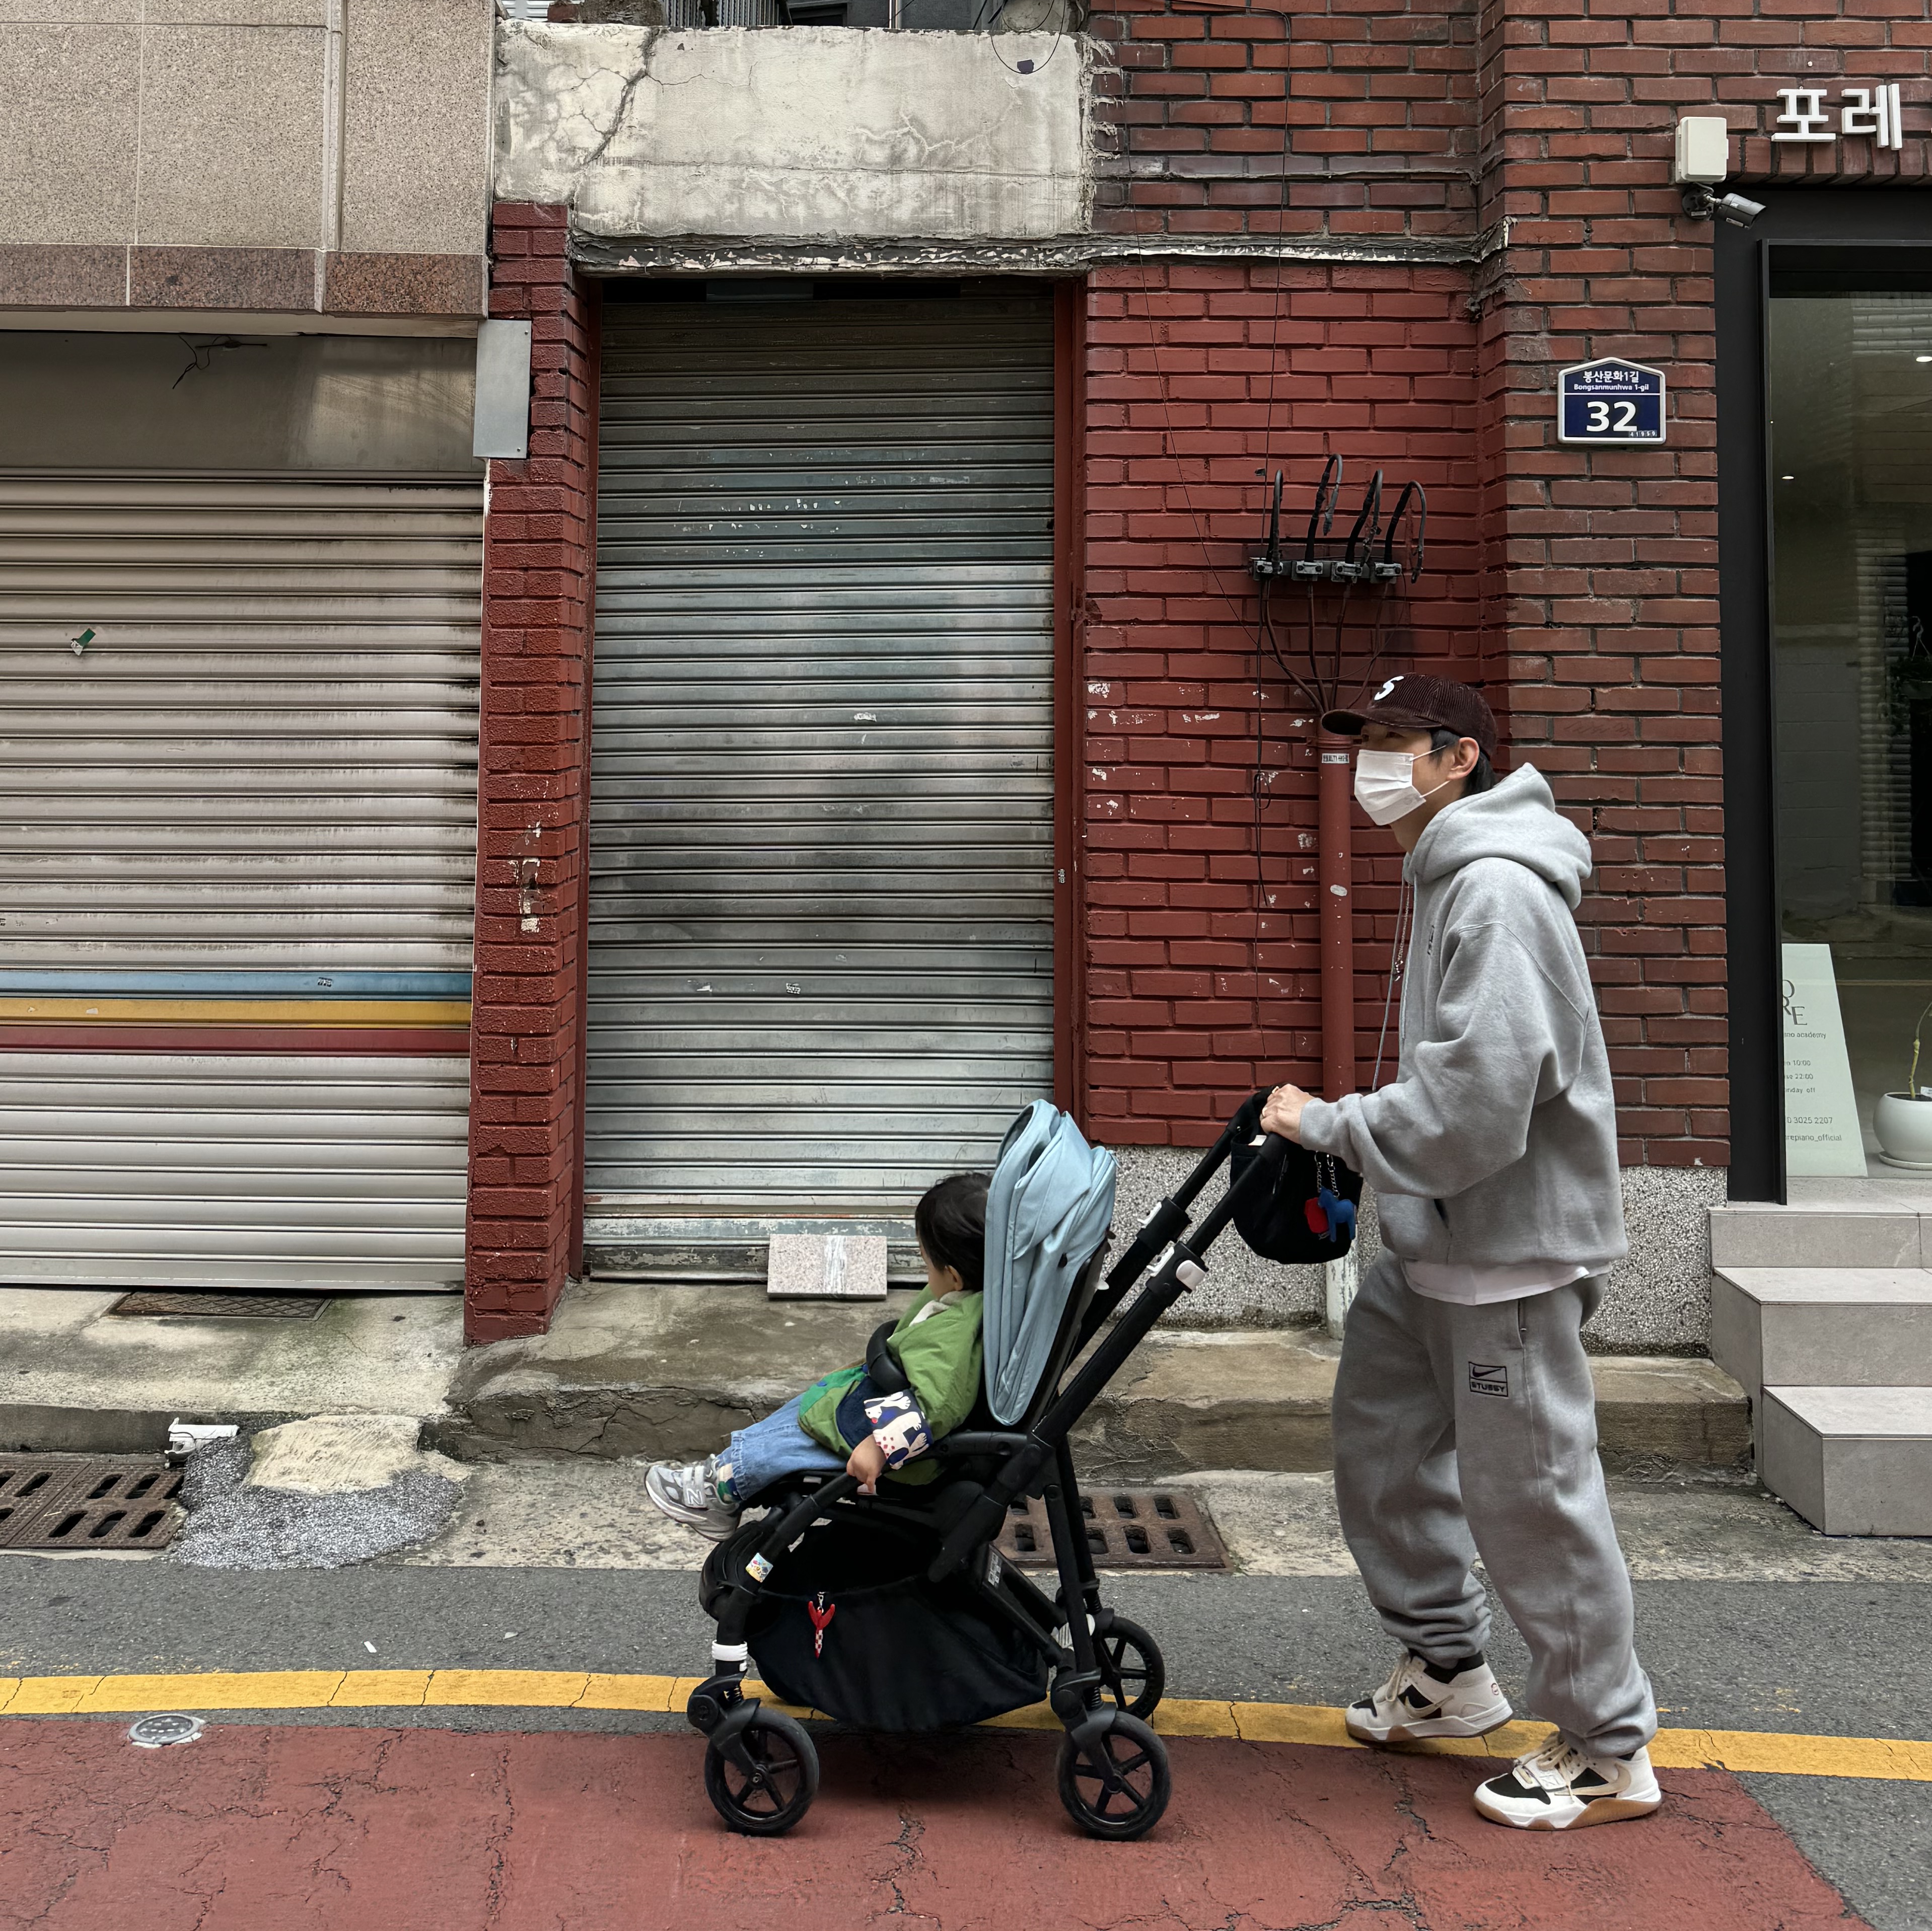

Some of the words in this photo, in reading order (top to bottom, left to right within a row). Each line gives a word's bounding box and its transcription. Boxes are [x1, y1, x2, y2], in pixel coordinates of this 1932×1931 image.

[1771, 83, 1902, 150] 포레
[1583, 370, 1639, 383] 봉산문화1길
[1634, 384, 1649, 392] 1-gil
[1587, 401, 1637, 432] 32
